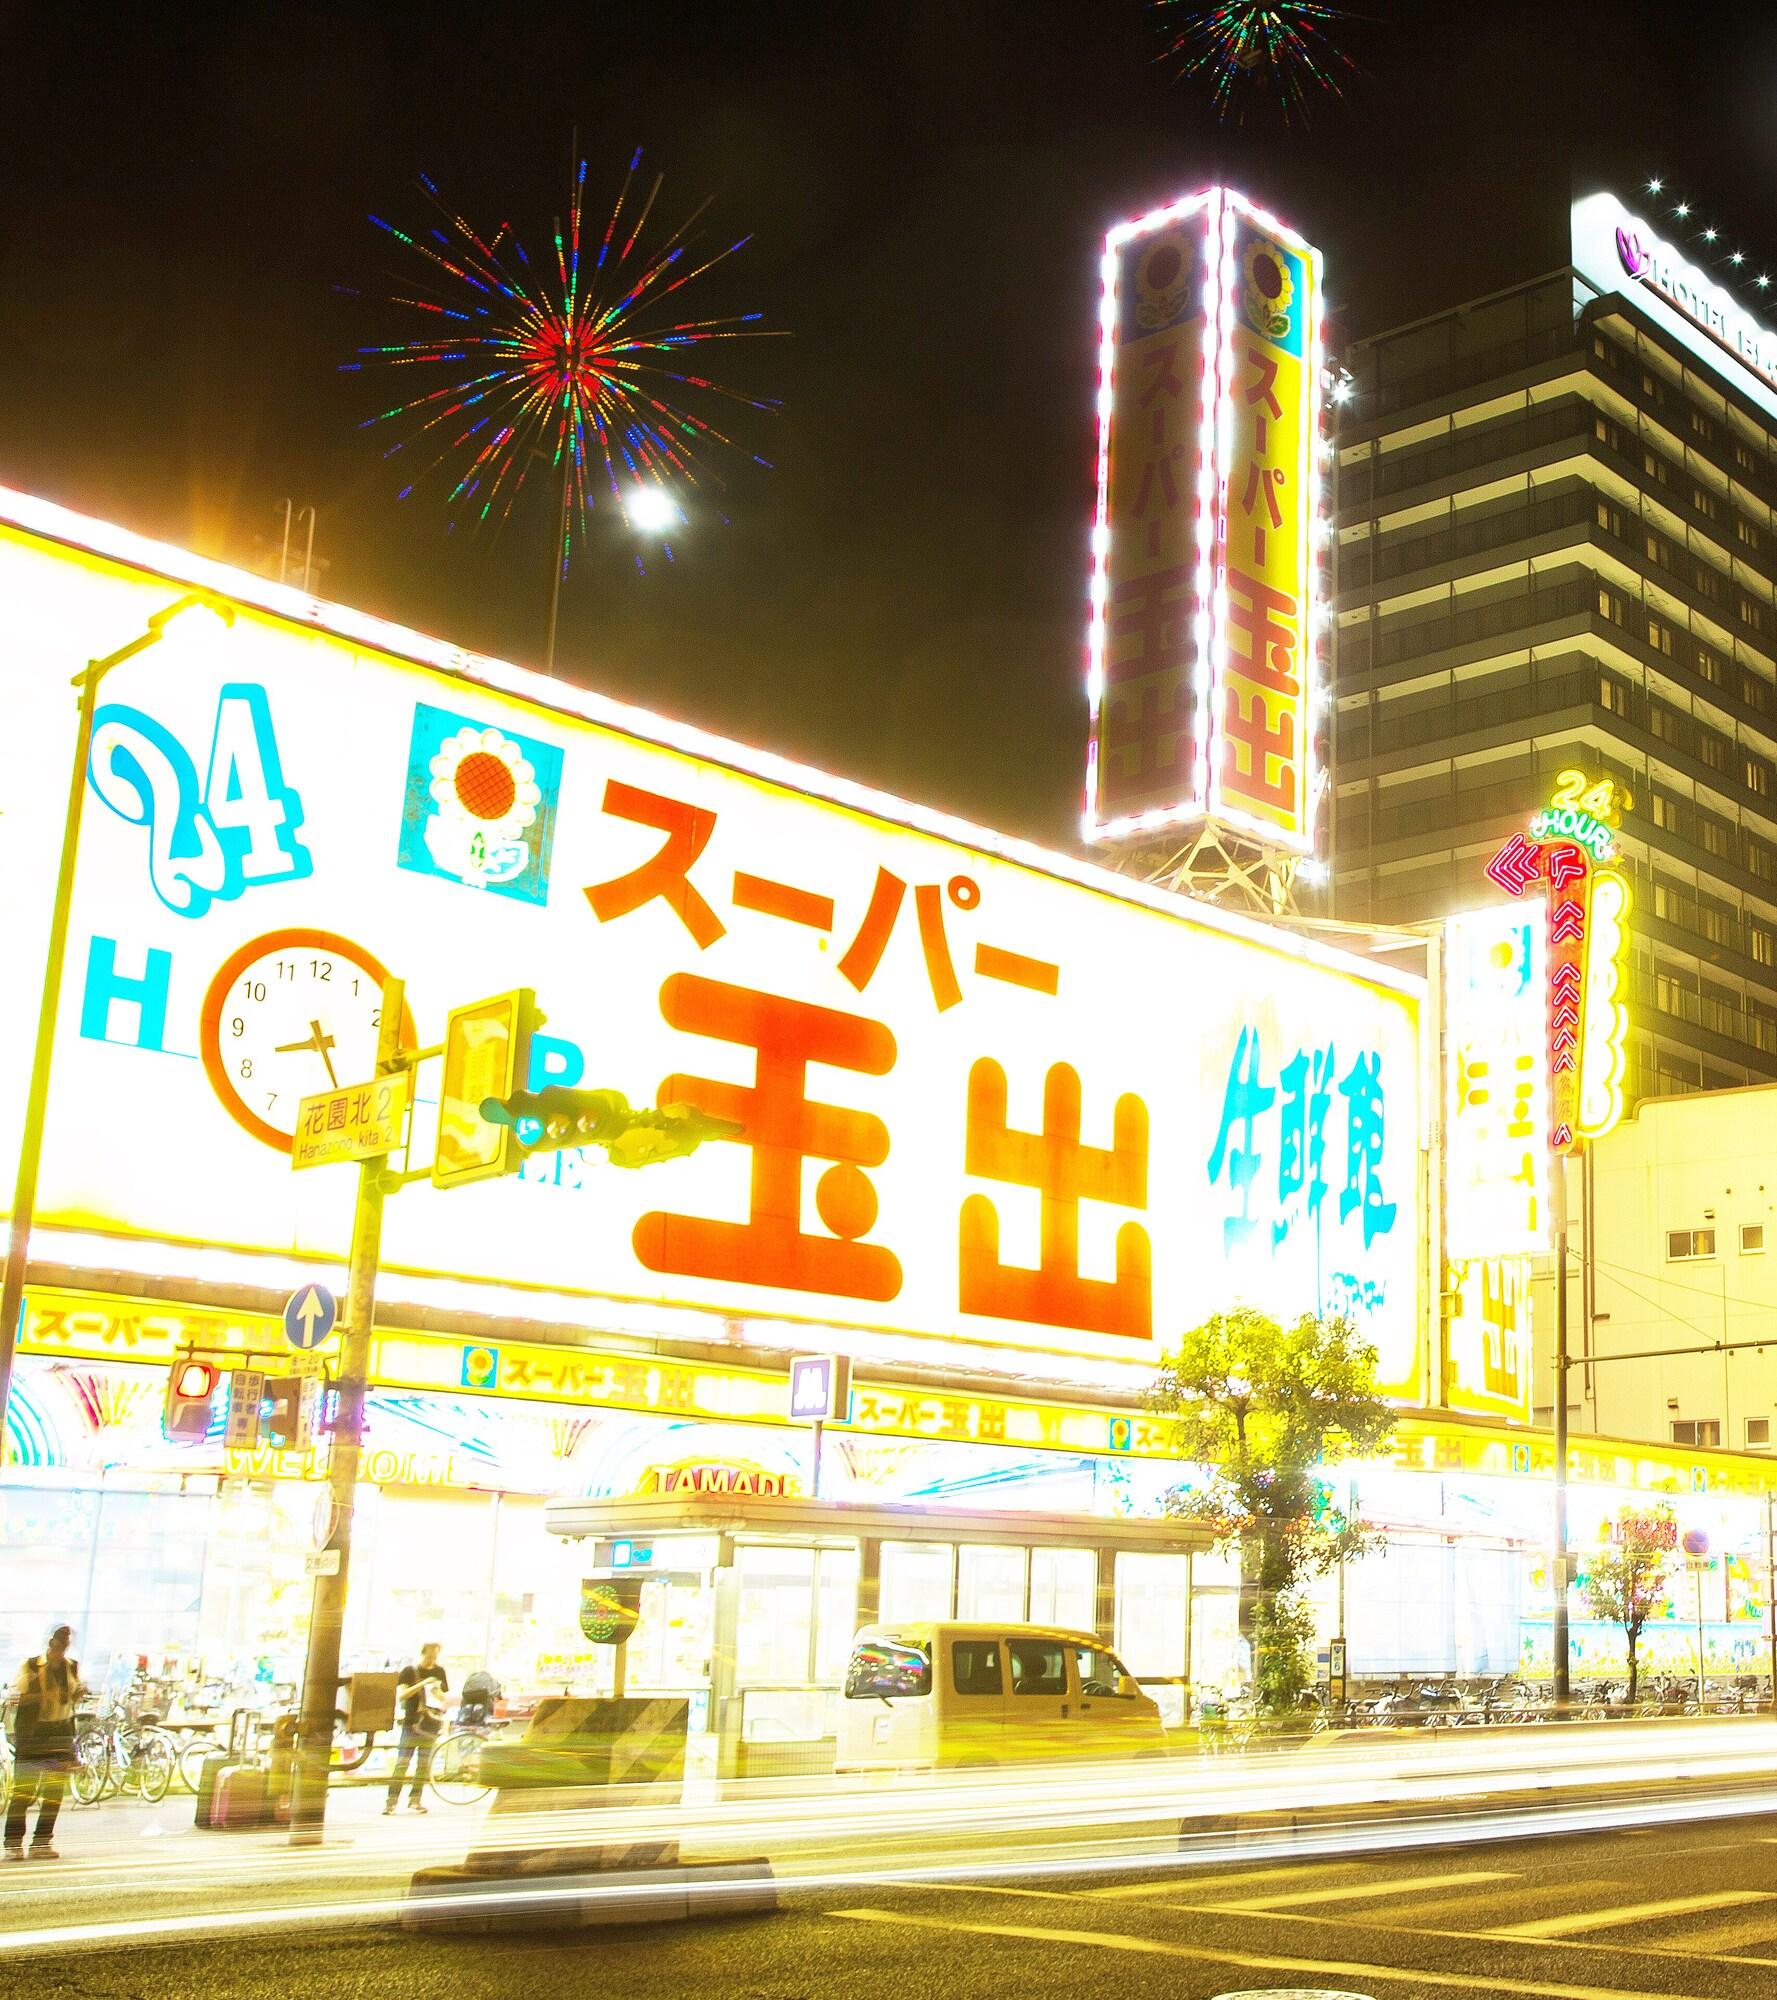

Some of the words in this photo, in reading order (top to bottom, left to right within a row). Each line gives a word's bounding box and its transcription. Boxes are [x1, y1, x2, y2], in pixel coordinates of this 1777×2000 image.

[1220, 346, 1300, 813] スーパー玉出
[87, 683, 314, 919] 24
[1551, 769, 1616, 820] 24
[1530, 810, 1613, 861] HOUR
[582, 778, 1060, 1014] スーパー
[243, 982, 267, 1003] 10
[276, 960, 296, 982] 11
[309, 960, 333, 983] 12
[231, 1017, 245, 1037] 9
[240, 1058, 253, 1080] 8
[266, 1092, 278, 1112] 7
[298, 1137, 353, 1161] Hanazono
[358, 1129, 380, 1148] kita
[632, 972, 1154, 1341] 玉出
[506, 1359, 695, 1408] スーパー玉出
[859, 1397, 1006, 1438] スーパー玉出
